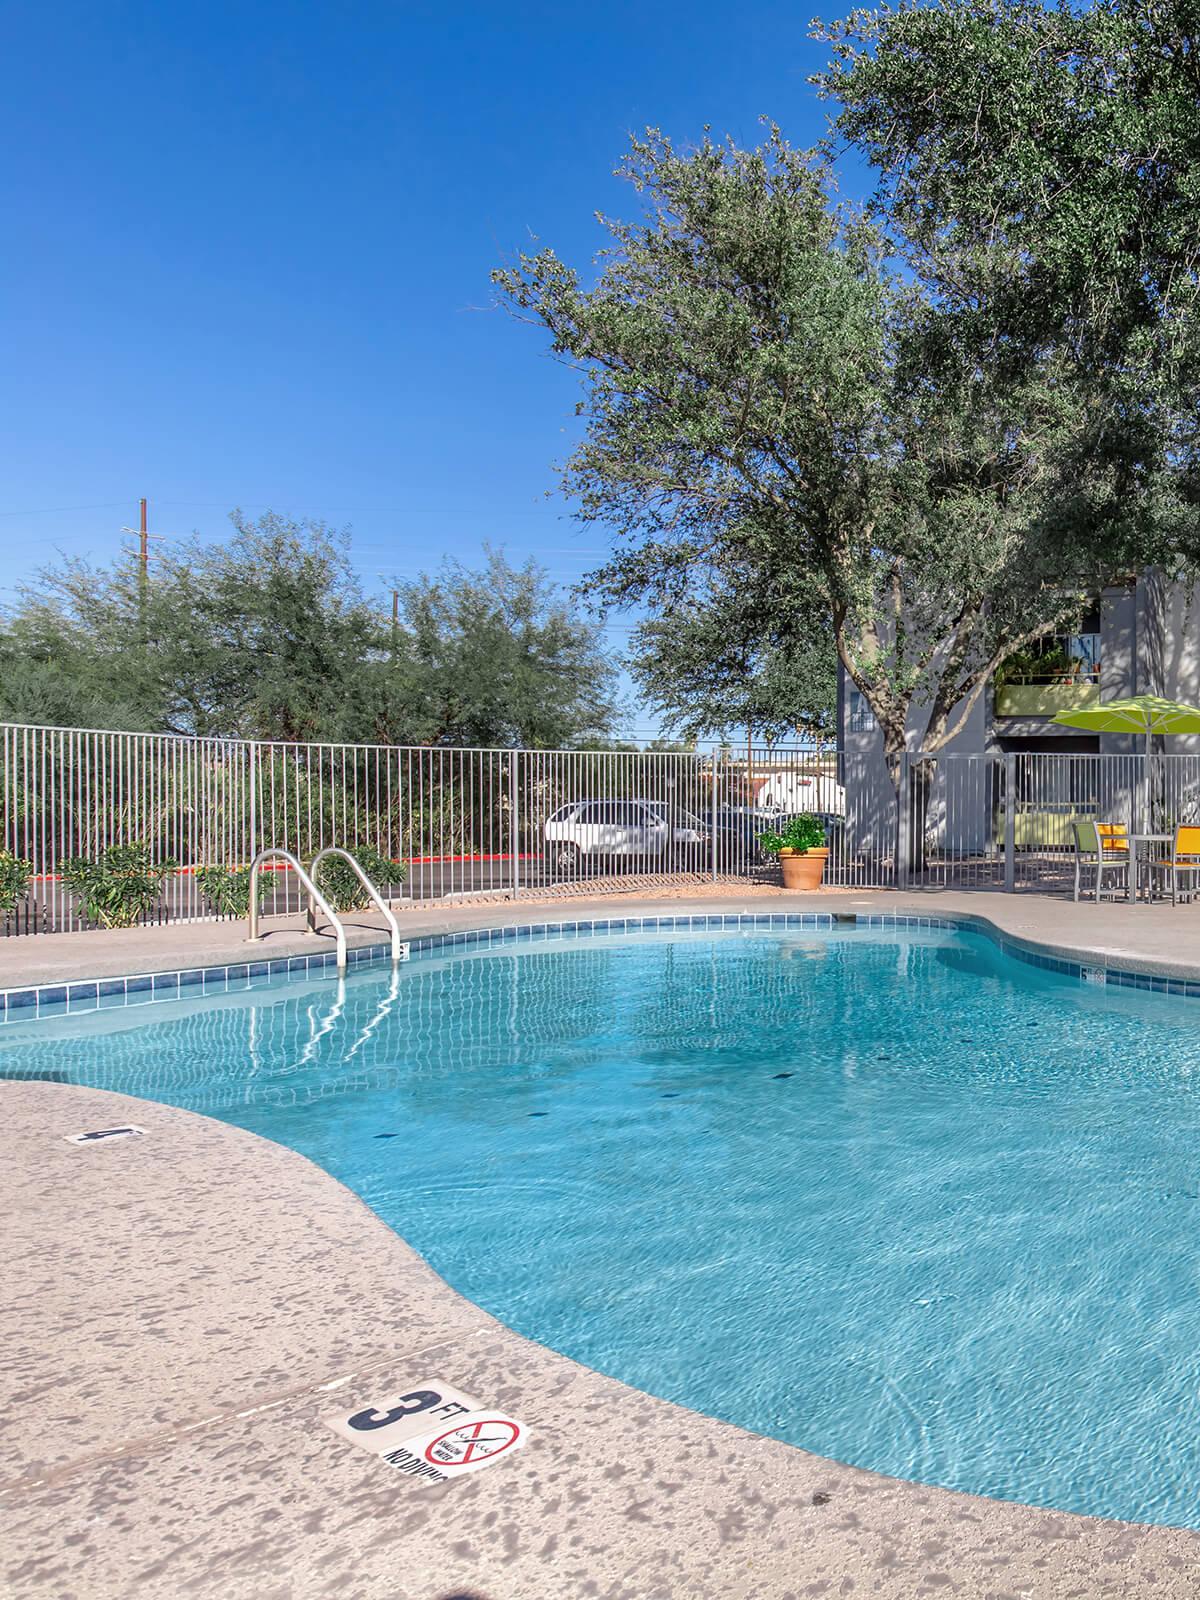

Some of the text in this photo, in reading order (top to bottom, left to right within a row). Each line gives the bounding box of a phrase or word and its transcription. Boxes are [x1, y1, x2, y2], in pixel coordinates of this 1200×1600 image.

[347, 1390, 471, 1431] 3 FT
[383, 1448, 413, 1464] NO
